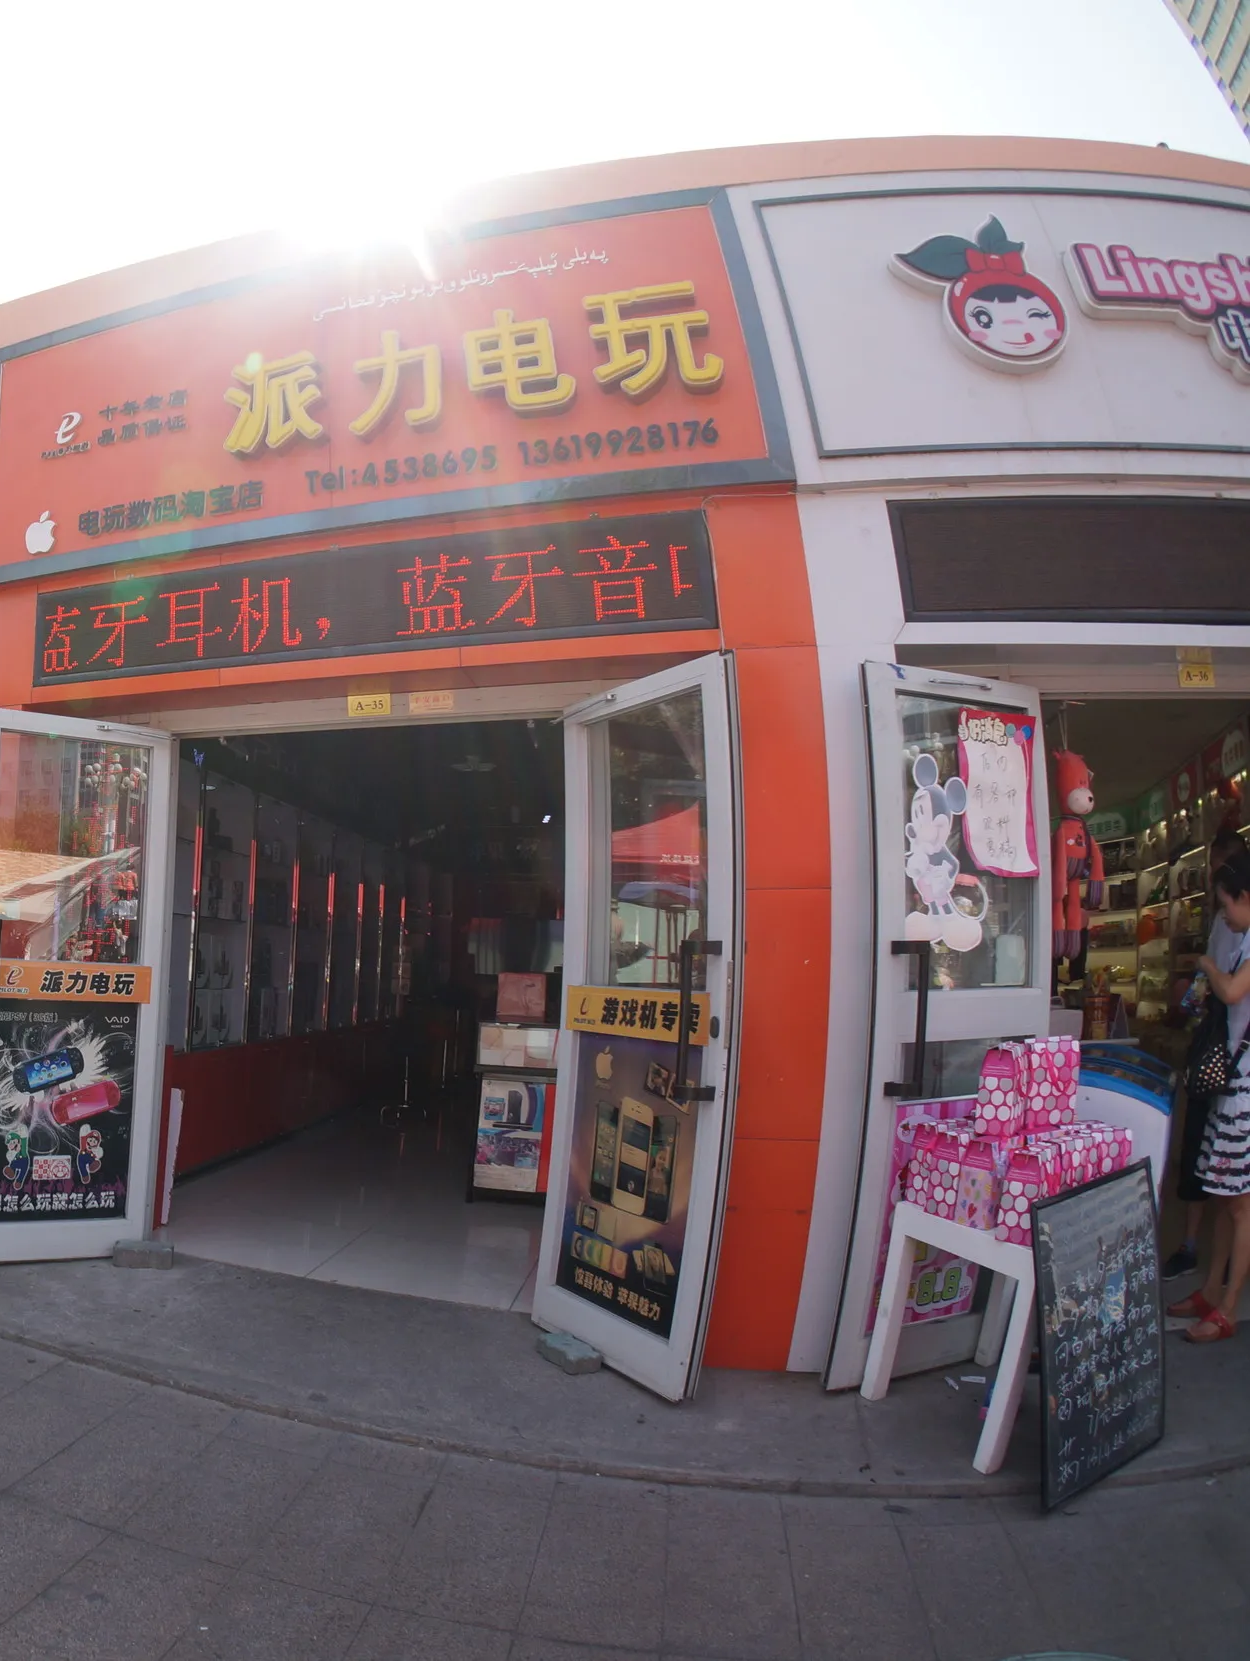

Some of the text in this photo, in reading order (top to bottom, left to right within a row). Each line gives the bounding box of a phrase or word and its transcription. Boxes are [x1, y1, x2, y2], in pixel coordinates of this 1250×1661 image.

[222, 280, 724, 456] 派力电玩
[517, 417, 720, 468] 13619928176
[77, 480, 264, 536] 电玩数码淘宝店
[1184, 669, 1209, 682] A-36
[355, 699, 384, 711] A-35
[967, 715, 1008, 747] 好消息
[39, 970, 136, 996] 派力电玩
[104, 1015, 130, 1024] VAIO
[574, 1266, 661, 1320] 惊喜体验 苹果魅力
